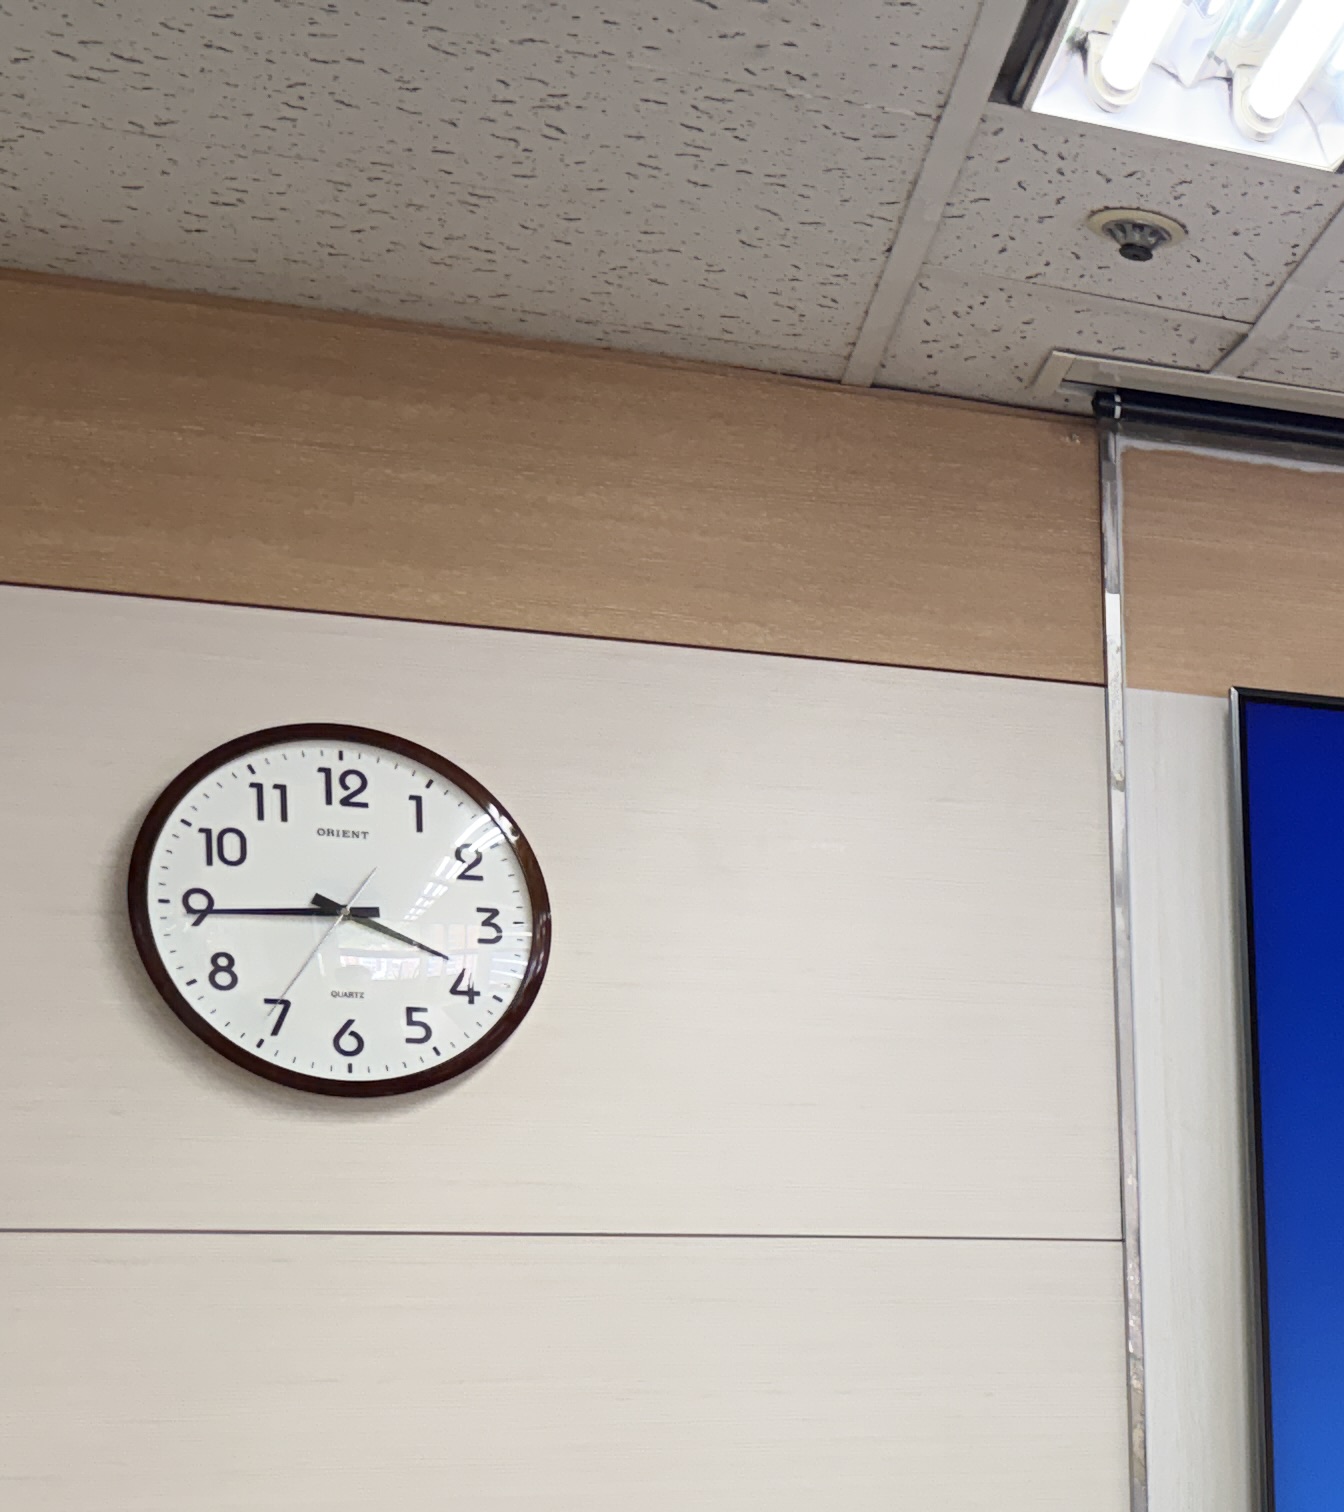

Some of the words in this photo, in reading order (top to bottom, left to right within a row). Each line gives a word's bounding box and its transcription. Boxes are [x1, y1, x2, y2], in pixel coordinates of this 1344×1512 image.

[249, 782, 288, 822] 11
[317, 766, 370, 809] 12
[408, 794, 424, 832] 1
[198, 827, 247, 866] 10
[317, 828, 369, 840] ORIENT
[453, 843, 484, 881] 2
[182, 888, 214, 927] 9
[476, 907, 503, 944] 3
[209, 951, 238, 991] 8
[449, 968, 481, 1004] 4
[330, 990, 365, 999] QUARTZ
[263, 998, 291, 1036] 7
[405, 1007, 433, 1043] 5
[332, 1018, 365, 1057] 6
